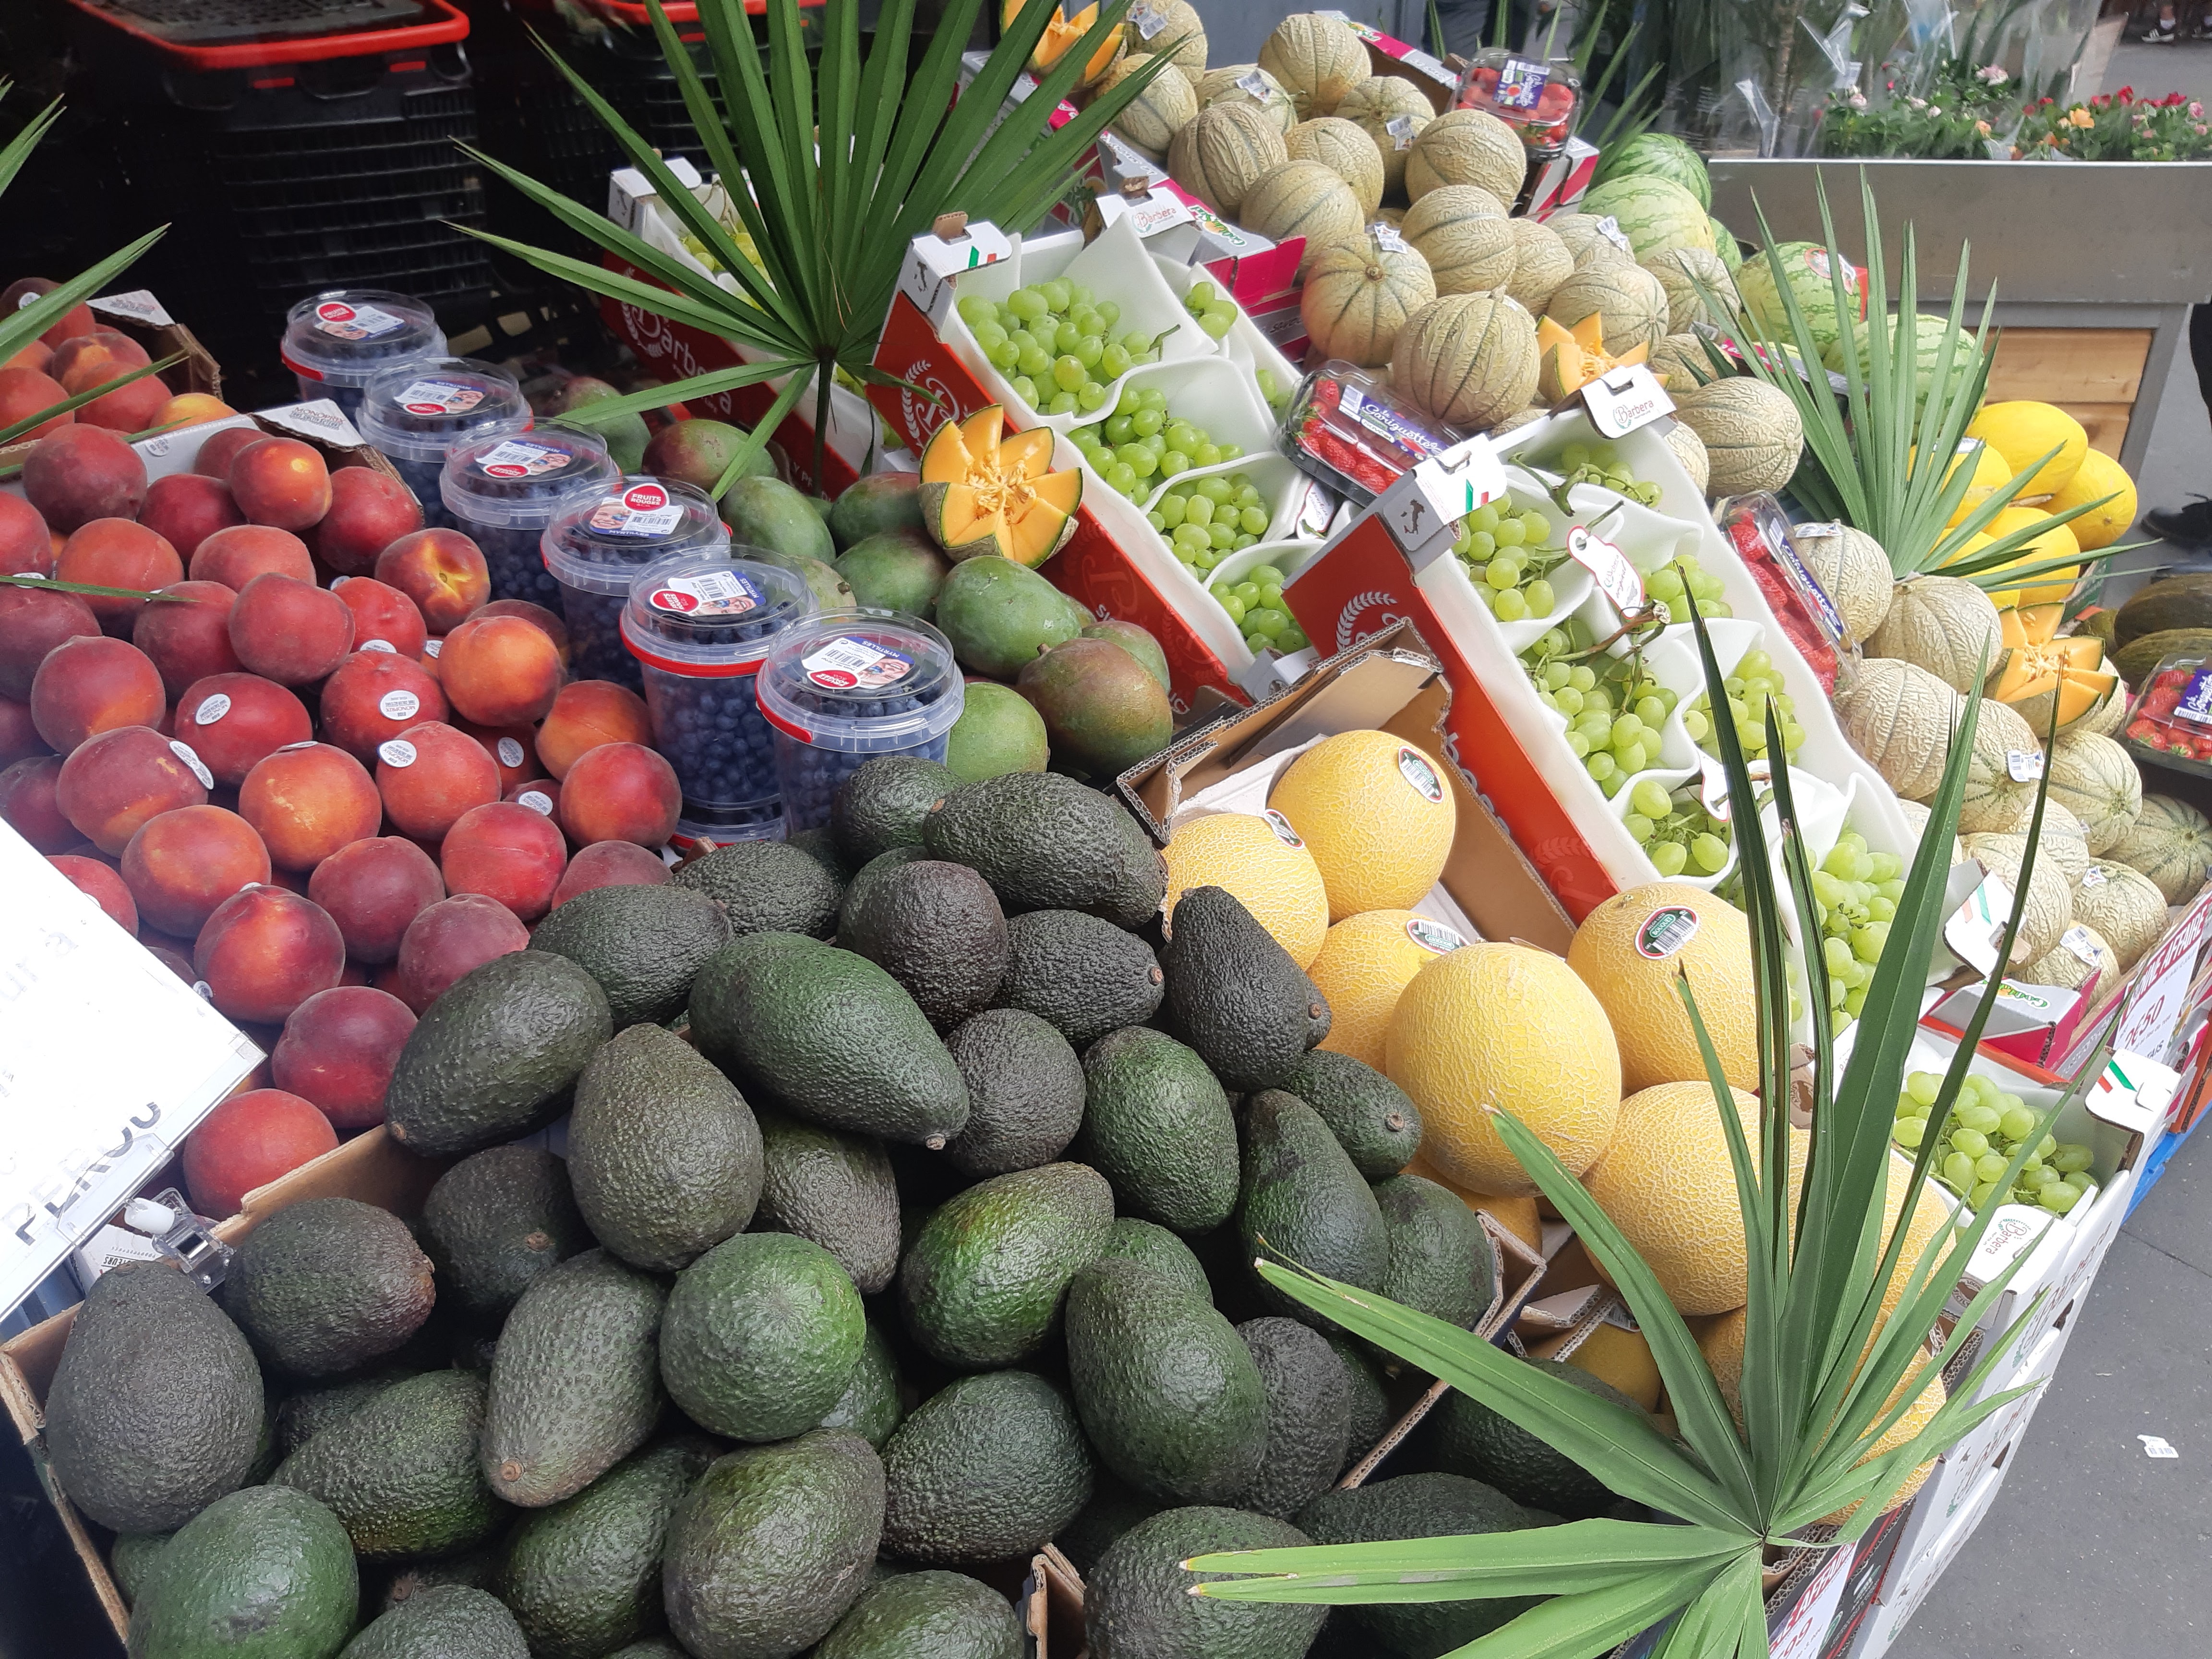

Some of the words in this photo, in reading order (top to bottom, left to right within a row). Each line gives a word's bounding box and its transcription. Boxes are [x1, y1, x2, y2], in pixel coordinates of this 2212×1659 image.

[1135, 207, 1177, 227] Barbera
[1615, 400, 1654, 423] Barbera
[1361, 404, 1438, 450] Gariguette
[740, 577, 759, 599] MYRTILLES
[663, 593, 678, 609] FRUITS
[671, 593, 685, 610] ROUGES
[862, 640, 901, 658] MYRTILLES
[1651, 916, 1673, 936] BOUQUET
[1428, 936, 1453, 948] BOUQUET
[2161, 904, 2208, 974] AFFAIRE
[1985, 1221, 2028, 1254] Barbera
